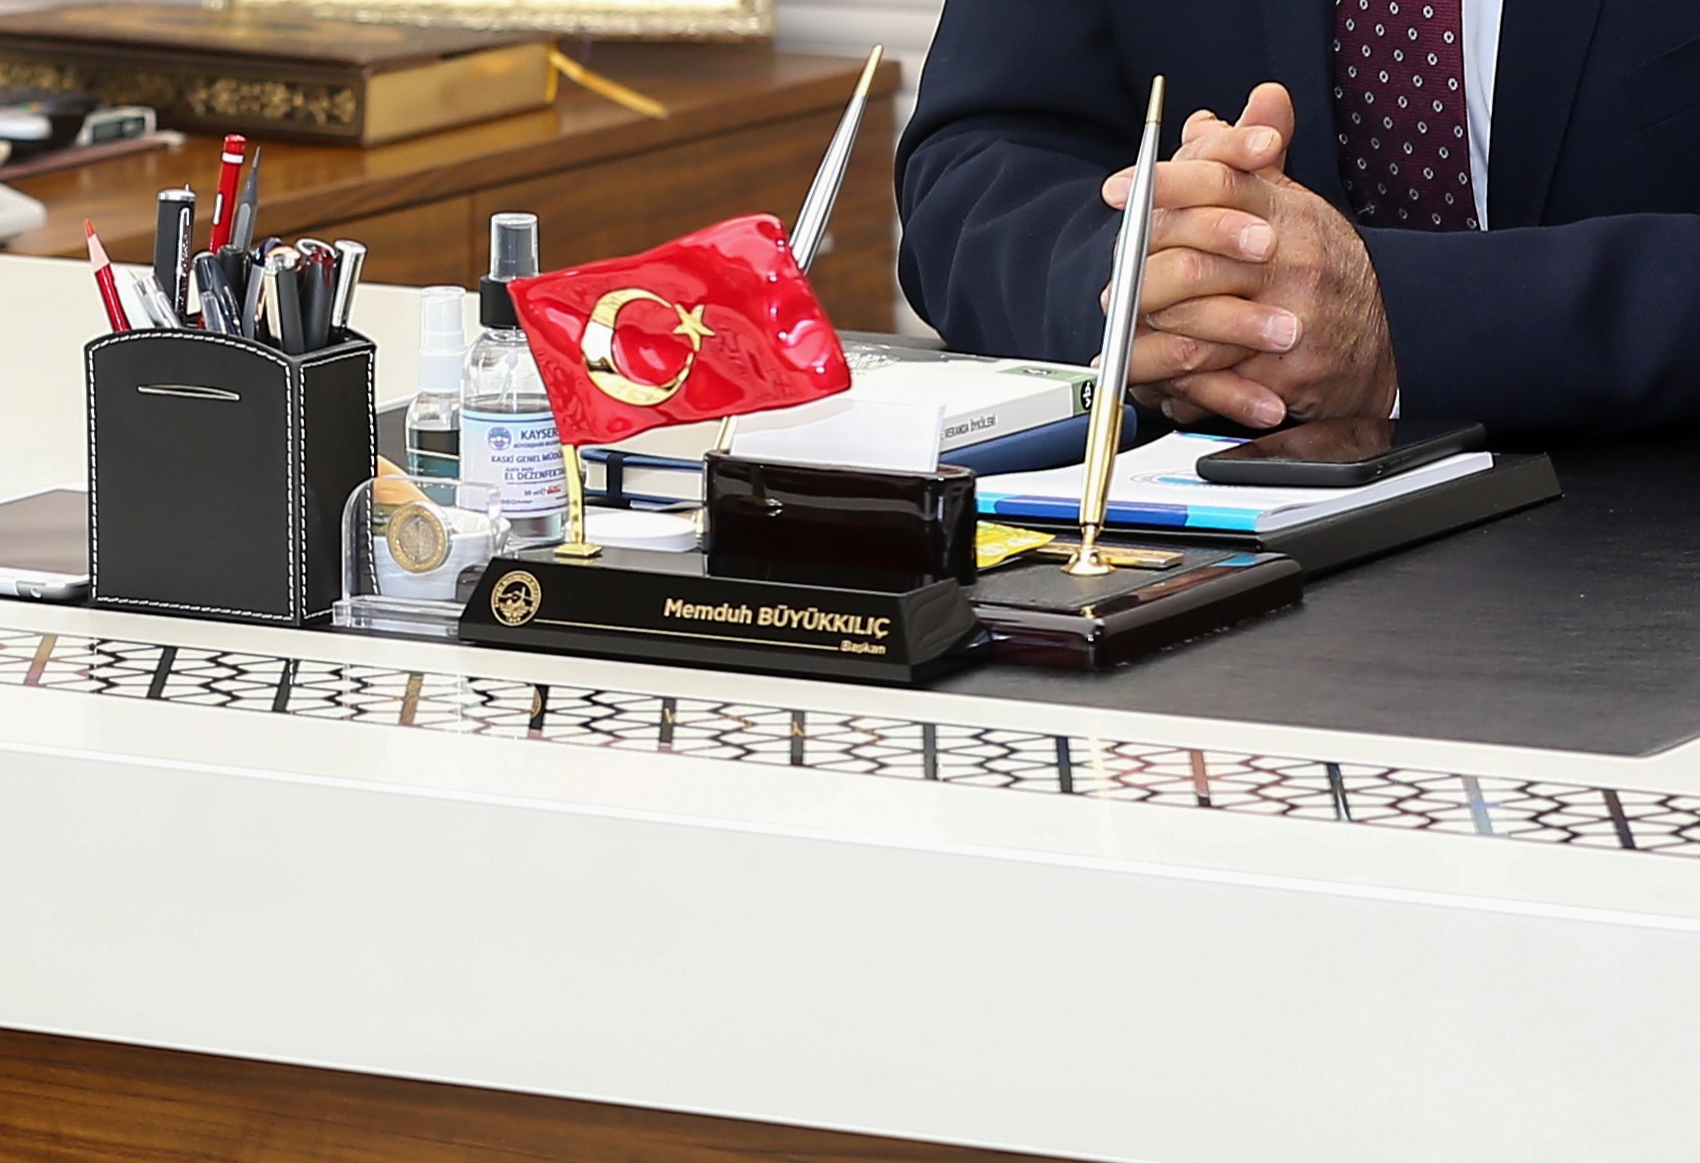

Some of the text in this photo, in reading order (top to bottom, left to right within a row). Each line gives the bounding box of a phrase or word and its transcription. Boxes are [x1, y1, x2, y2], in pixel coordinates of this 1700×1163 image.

[521, 428, 559, 440] KAYSER
[516, 455, 540, 463] GENEL
[663, 597, 891, 639] Memduh BÜYÜKKILIÇ
[840, 639, 887, 656] Başkan
